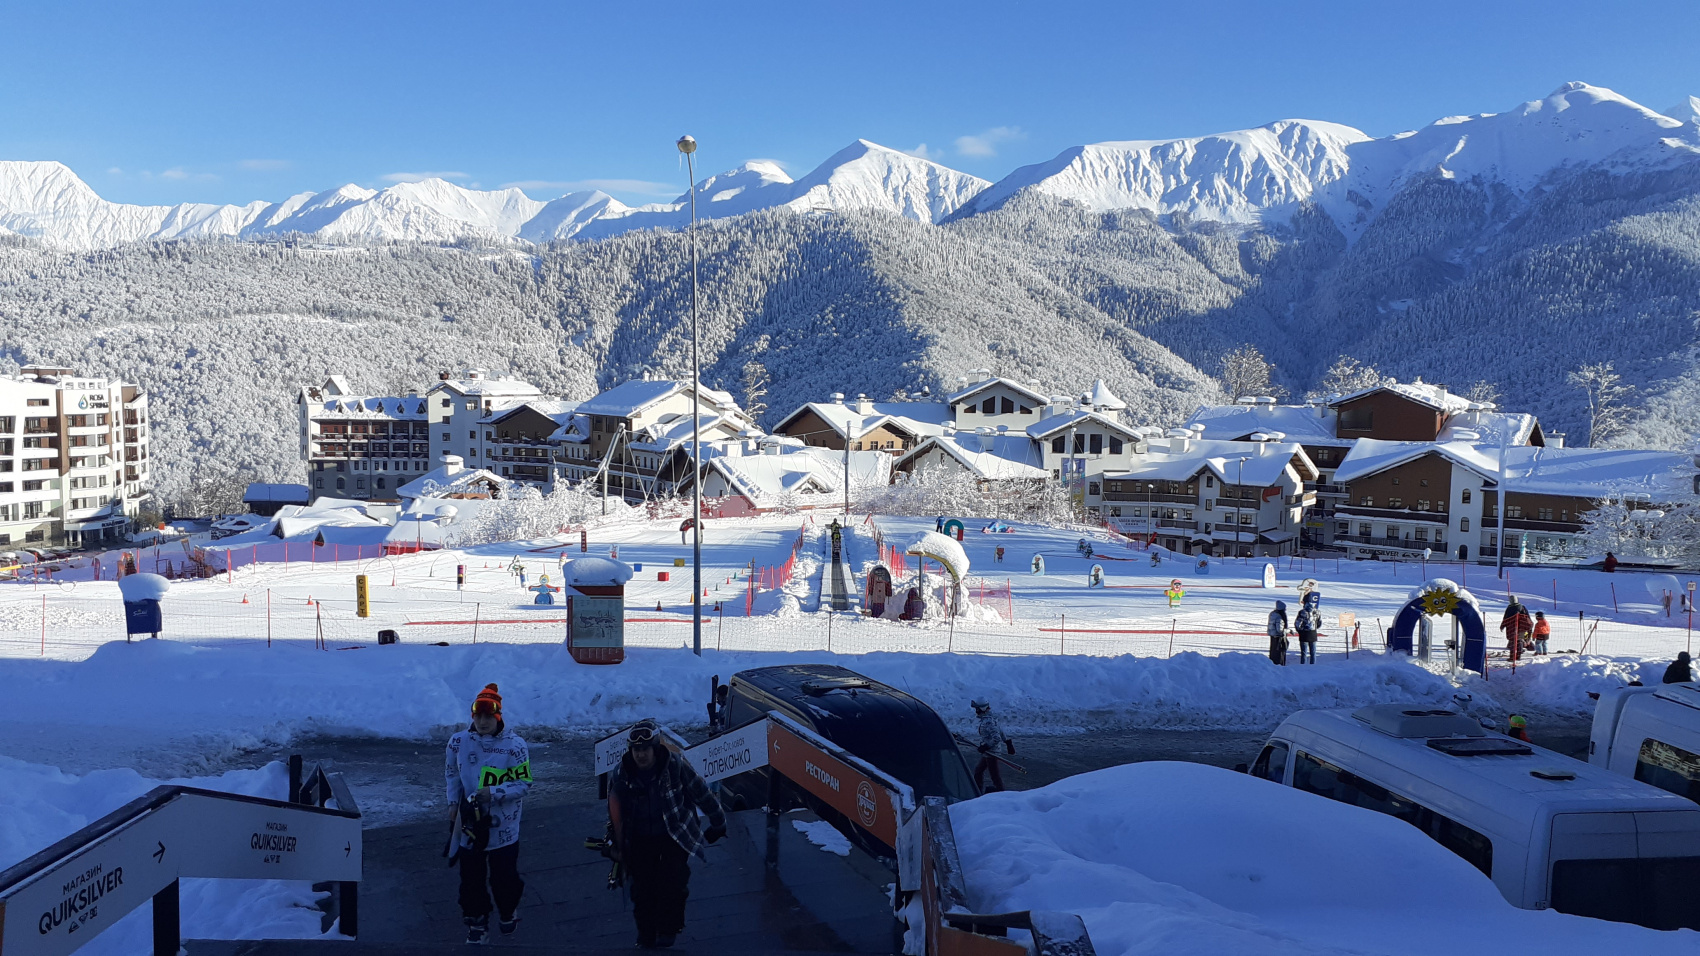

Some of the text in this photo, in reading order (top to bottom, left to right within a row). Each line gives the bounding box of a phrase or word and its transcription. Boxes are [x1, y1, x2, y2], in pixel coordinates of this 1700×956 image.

[805, 759, 840, 793] РЕСТОРАН
[250, 832, 297, 852] QUIKSILVER
[62, 863, 102, 895] МАГАЗИН
[38, 866, 123, 935] QUIKSILVER
